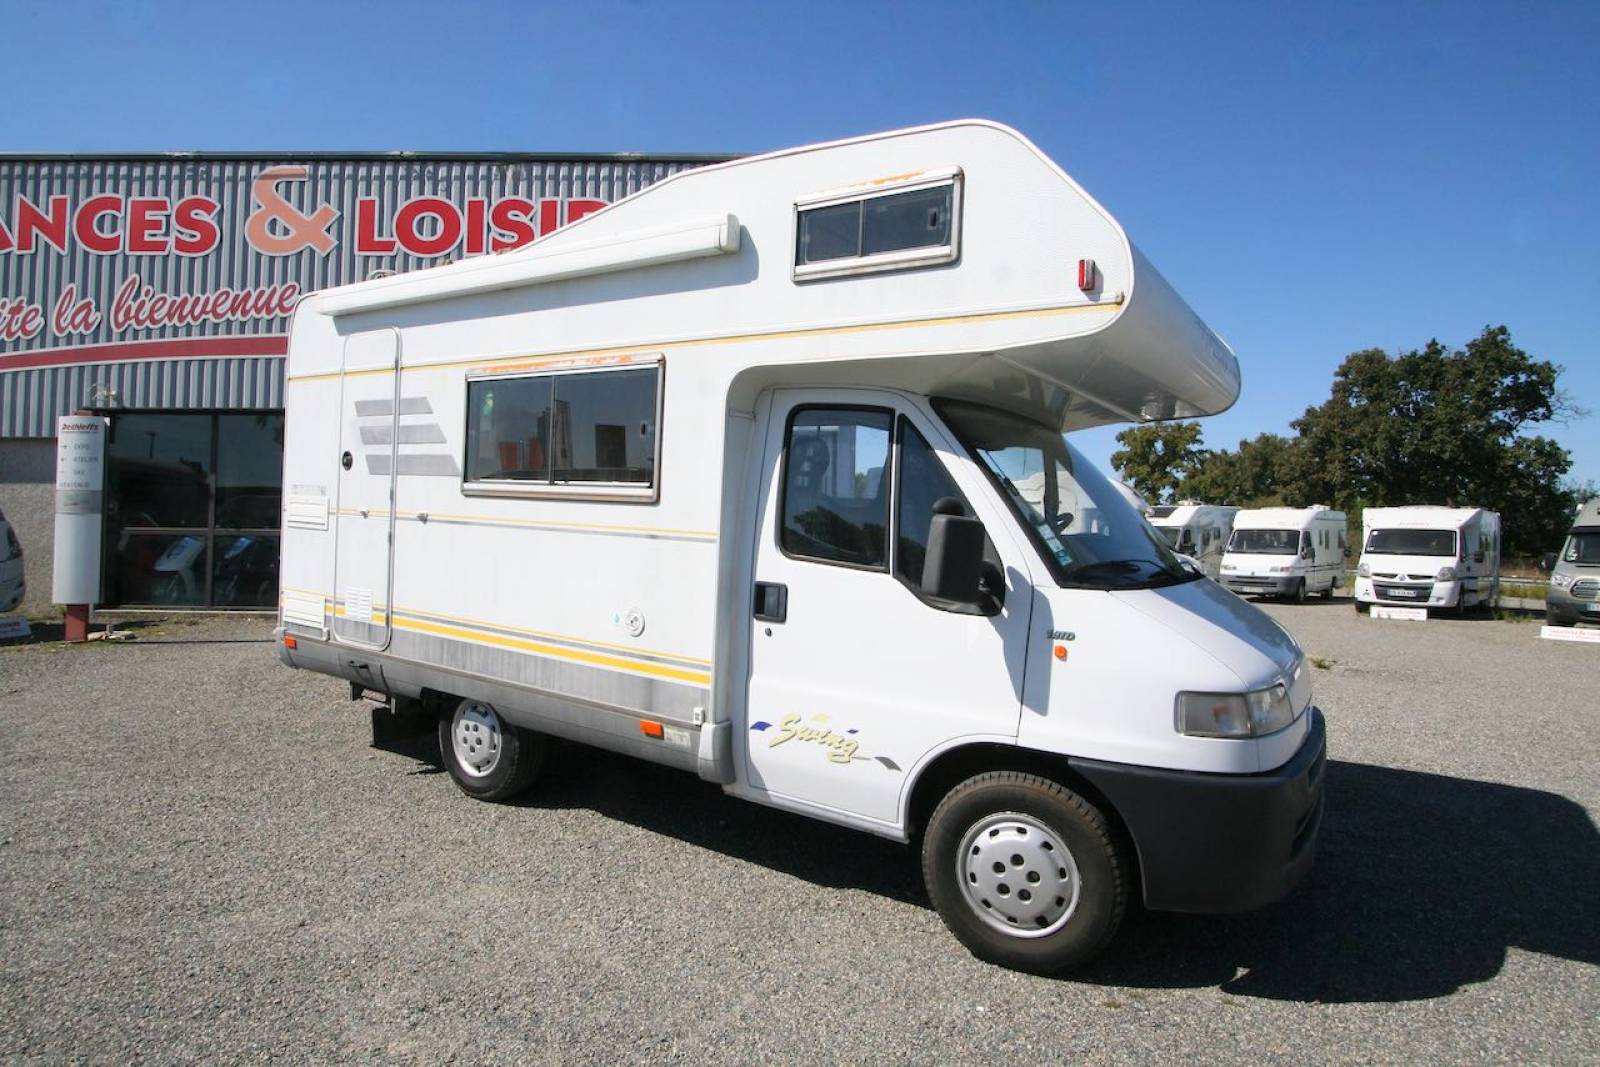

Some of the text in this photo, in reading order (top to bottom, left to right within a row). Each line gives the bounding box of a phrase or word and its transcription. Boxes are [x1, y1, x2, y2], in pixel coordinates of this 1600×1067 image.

[246, 165, 340, 256] &
[53, 284, 100, 336] la
[110, 274, 299, 333] bienvenue
[769, 713, 859, 763] Swing
